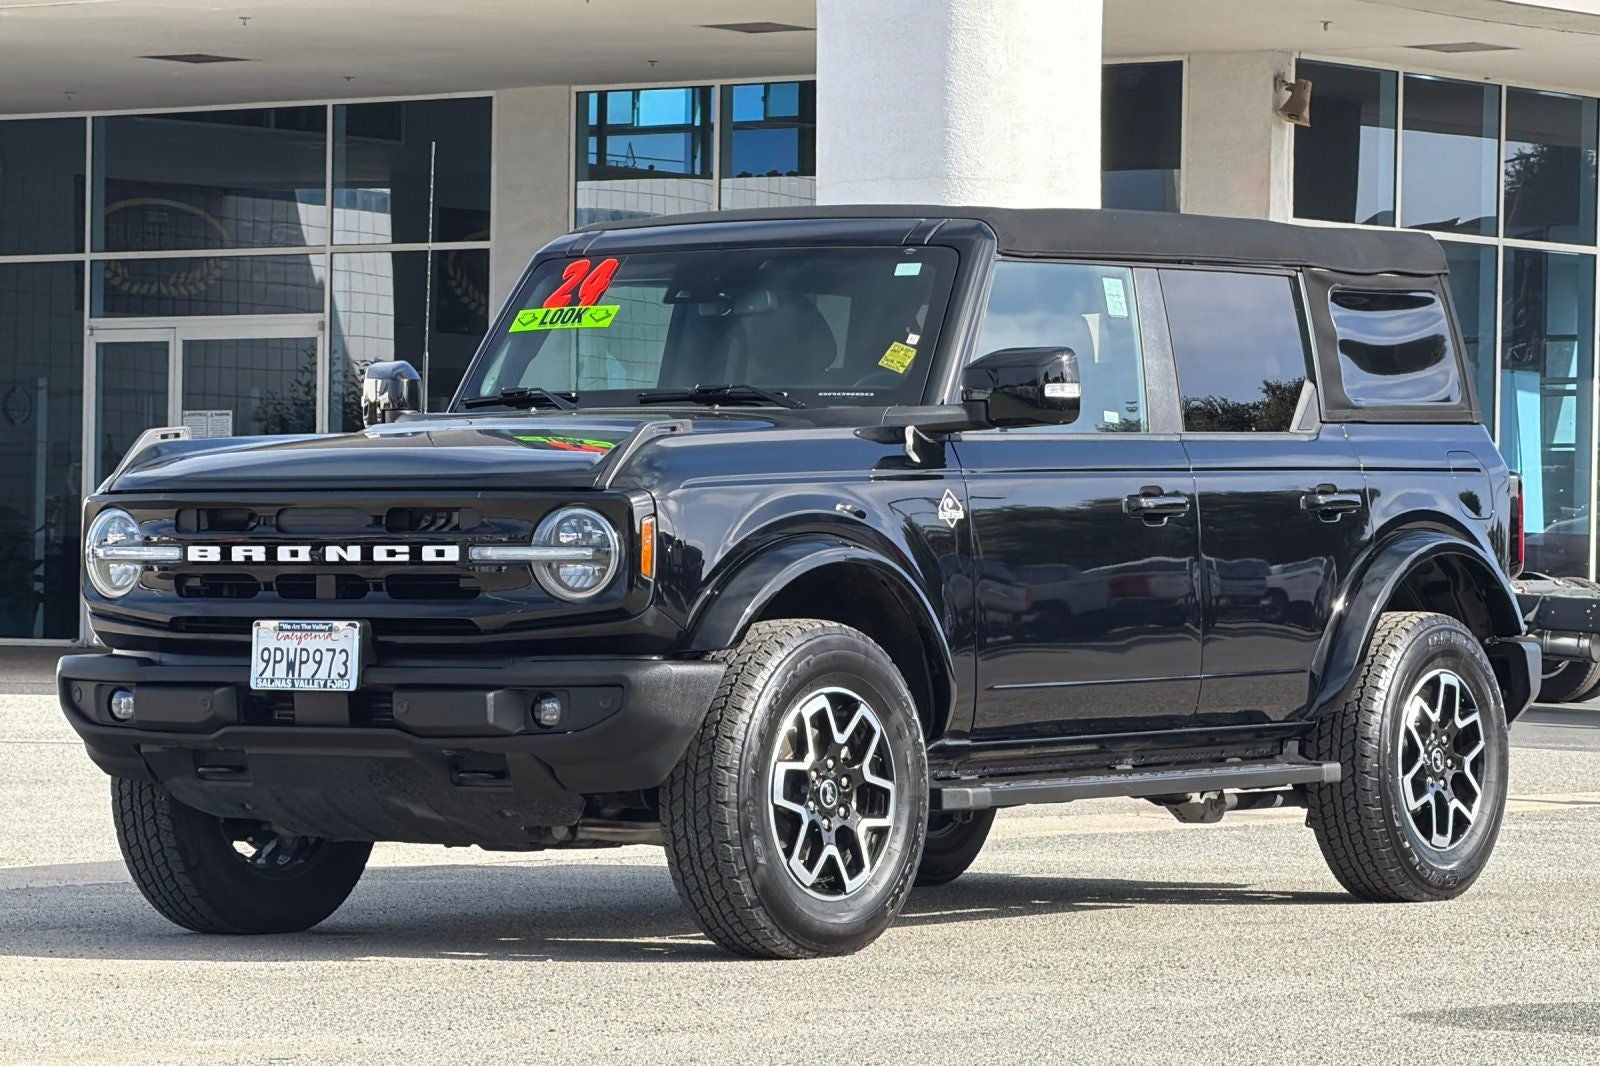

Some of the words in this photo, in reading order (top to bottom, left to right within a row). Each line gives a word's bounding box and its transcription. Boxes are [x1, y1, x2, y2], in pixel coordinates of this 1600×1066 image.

[542, 258, 619, 309] 24
[538, 307, 590, 327] LOOK
[187, 545, 460, 562] BRONCO
[276, 632, 339, 646] California
[258, 647, 349, 679] 9PWP973
[293, 679, 324, 688] VALLEY
[327, 680, 349, 689] FORD
